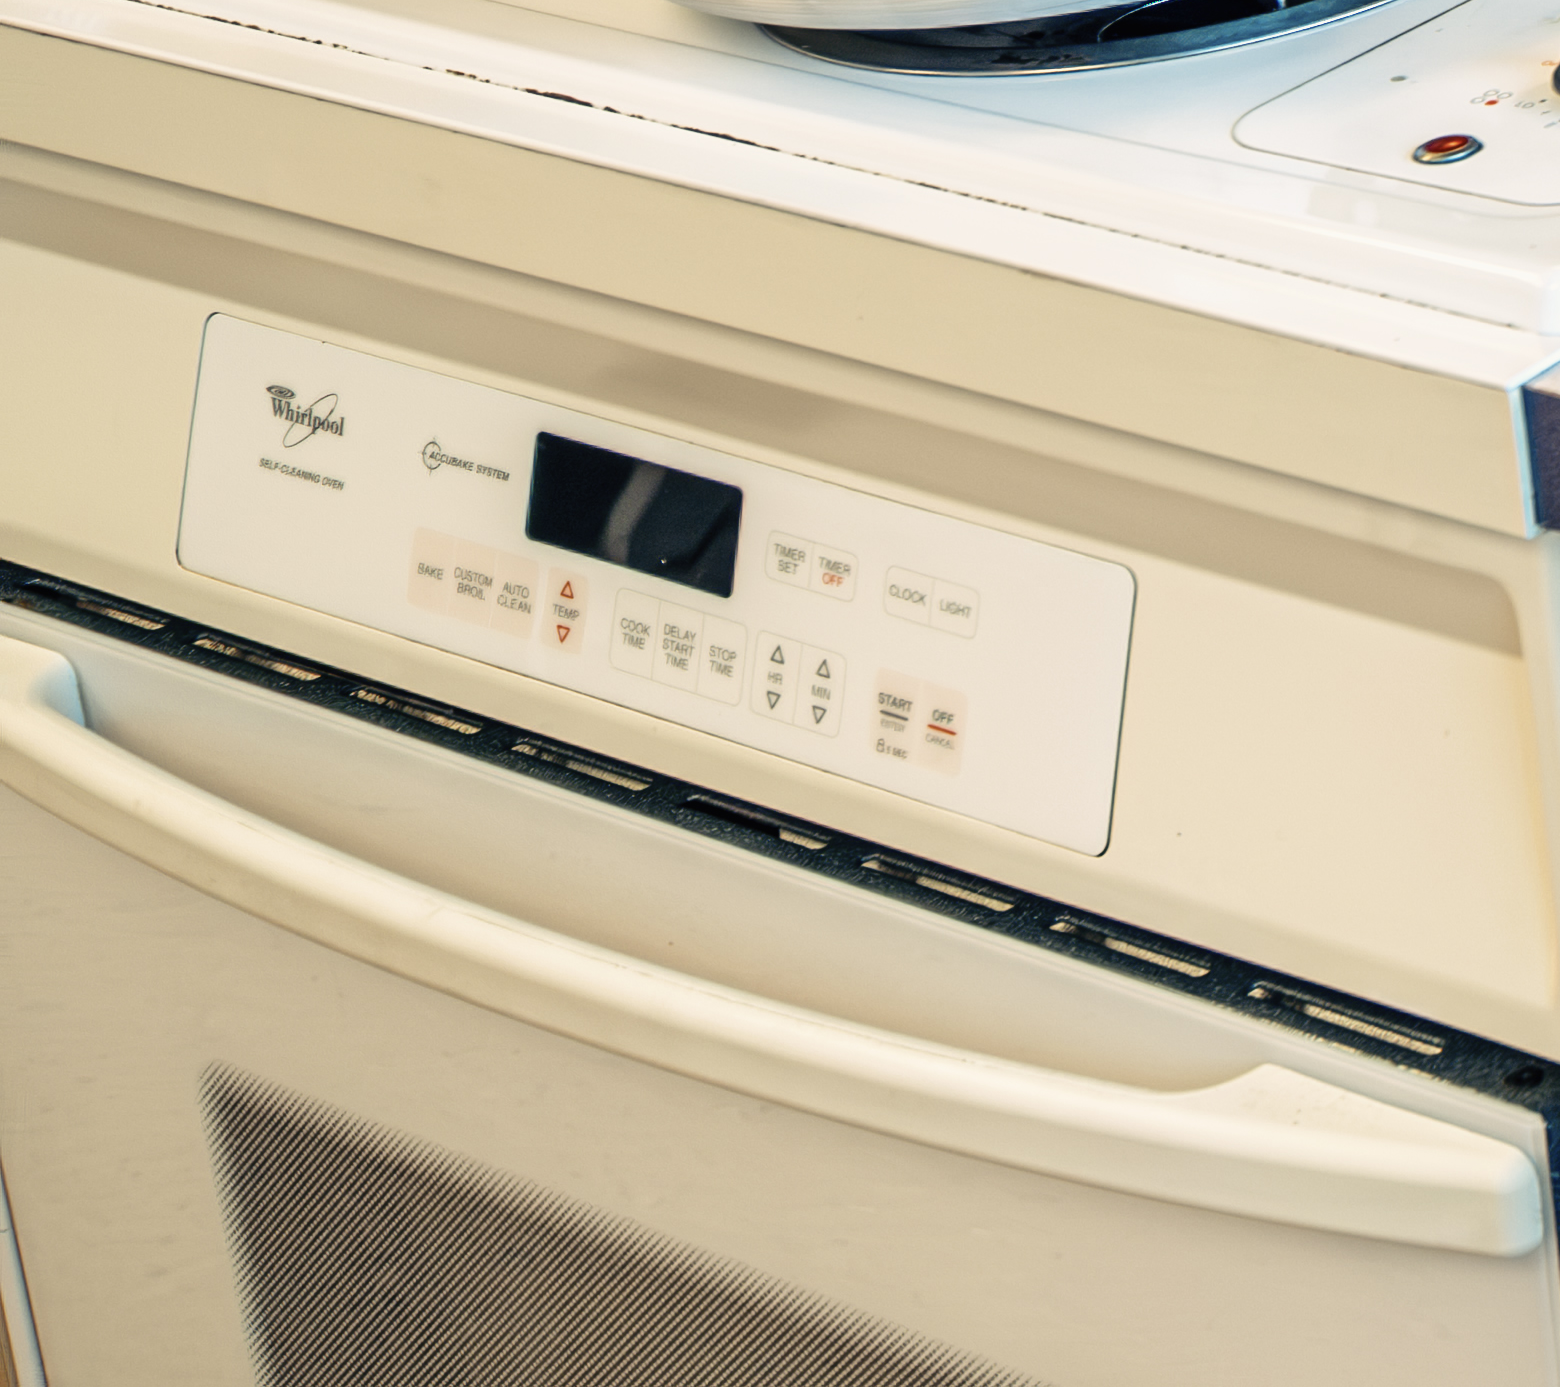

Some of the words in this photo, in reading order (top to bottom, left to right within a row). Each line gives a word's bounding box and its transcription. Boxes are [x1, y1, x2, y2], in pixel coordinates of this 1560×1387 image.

[271, 397, 344, 437] Whirlpool
[259, 457, 321, 485] SELF-CLEANING
[321, 475, 344, 491] OVEN
[429, 450, 474, 472] ACCUBAKE
[476, 463, 510, 482] SYSTEM
[773, 543, 806, 563] TIMER
[417, 562, 444, 580] BAKE
[777, 560, 799, 575] SET
[818, 556, 851, 575] TIMER
[454, 567, 493, 588] CUSTOM
[822, 572, 845, 588] OFF
[502, 581, 530, 600] AUTO
[889, 584, 927, 606] CLOCK
[498, 594, 532, 615] CLEAN
[553, 603, 580, 621] TEMP
[939, 599, 972, 618] LIGHT
[620, 618, 650, 637] COOK
[663, 623, 697, 642] DELAY
[622, 632, 647, 651] TIME
[662, 638, 694, 657] START
[665, 653, 690, 671] TIME
[709, 645, 737, 662] STOP
[709, 660, 734, 678] TIME
[767, 671, 783, 686] HR
[811, 685, 831, 702] MIN
[878, 692, 913, 712] START
[932, 709, 955, 725] OFF
